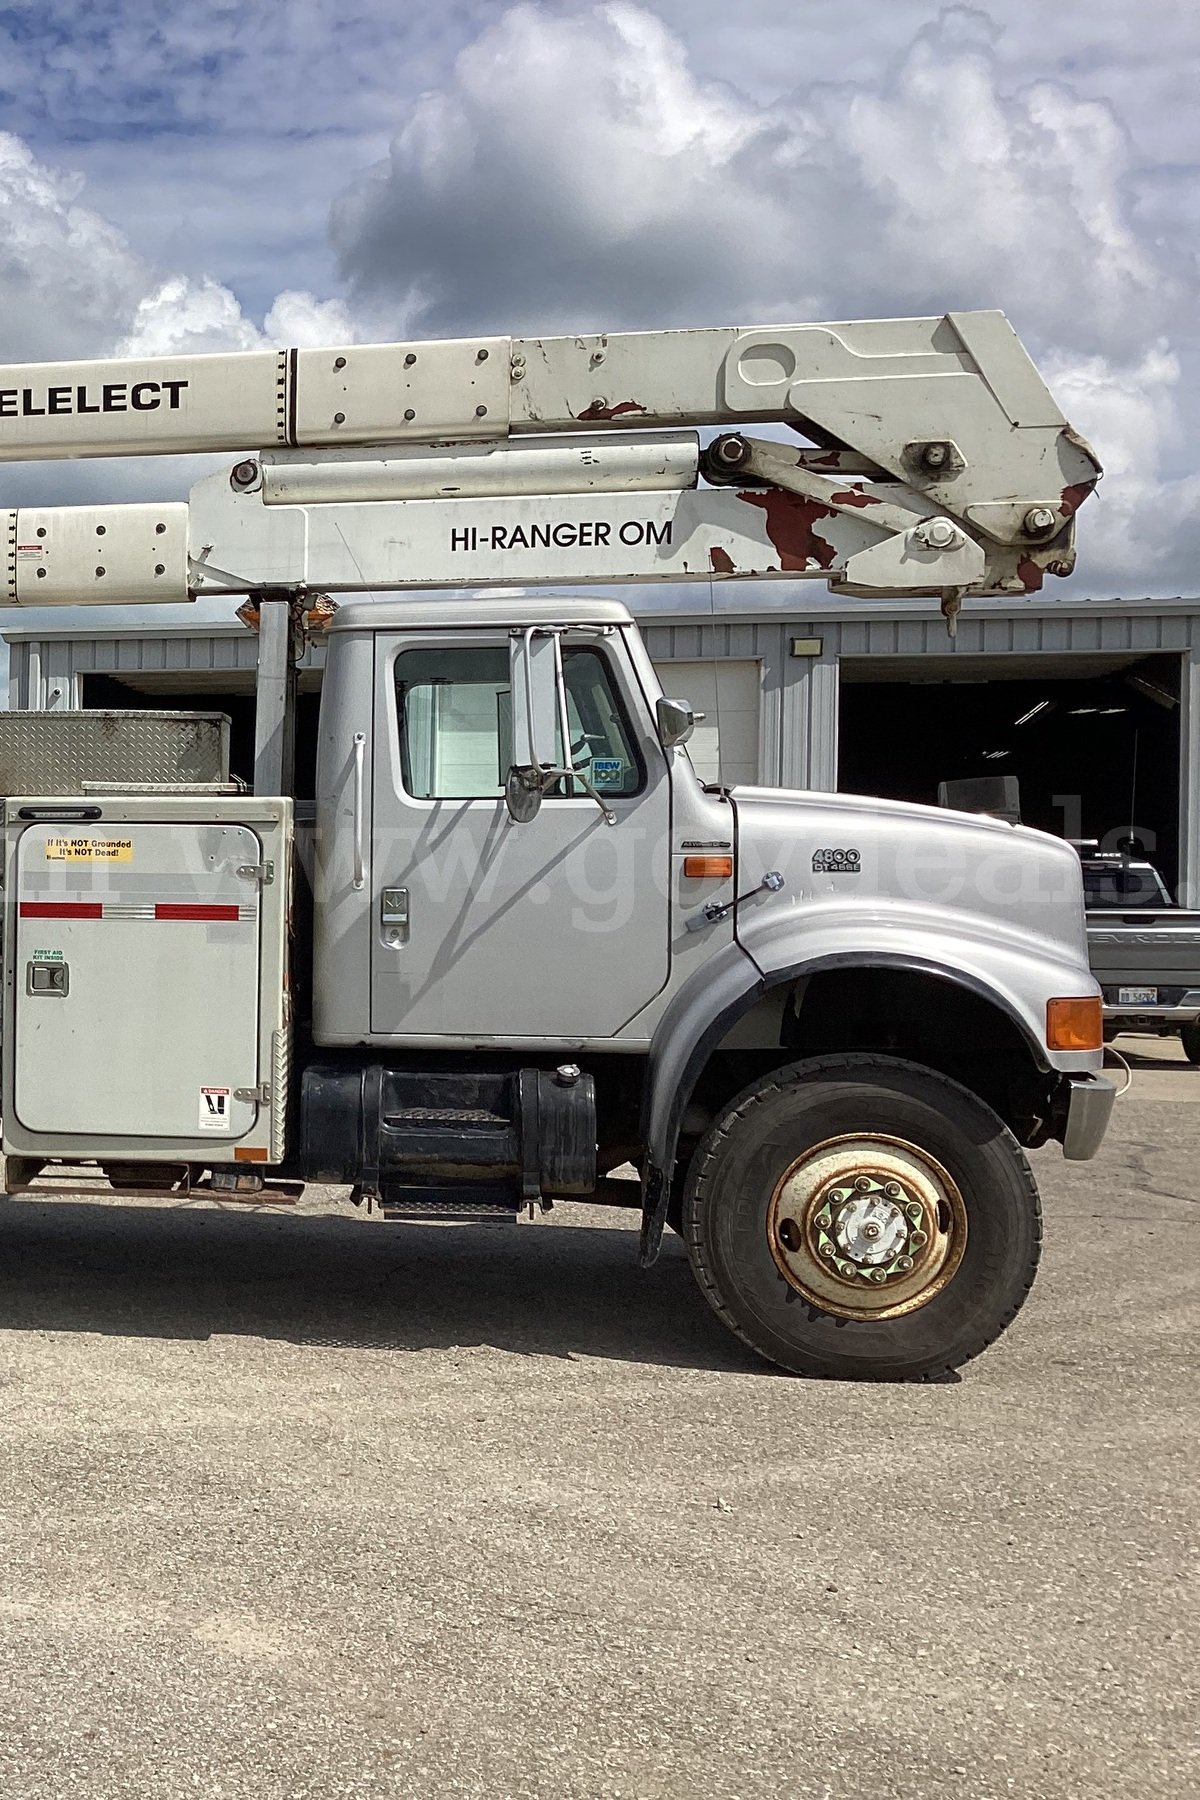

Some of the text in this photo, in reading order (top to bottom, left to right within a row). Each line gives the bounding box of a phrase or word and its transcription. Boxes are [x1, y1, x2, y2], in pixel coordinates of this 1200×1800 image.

[451, 521, 672, 551] HI-RANGER OM
[594, 761, 620, 769] IBEW
[47, 839, 131, 848] If It's NOT Grounded
[74, 848, 93, 856] NOT
[95, 849, 119, 857] Dead!
[812, 849, 861, 863] 4800
